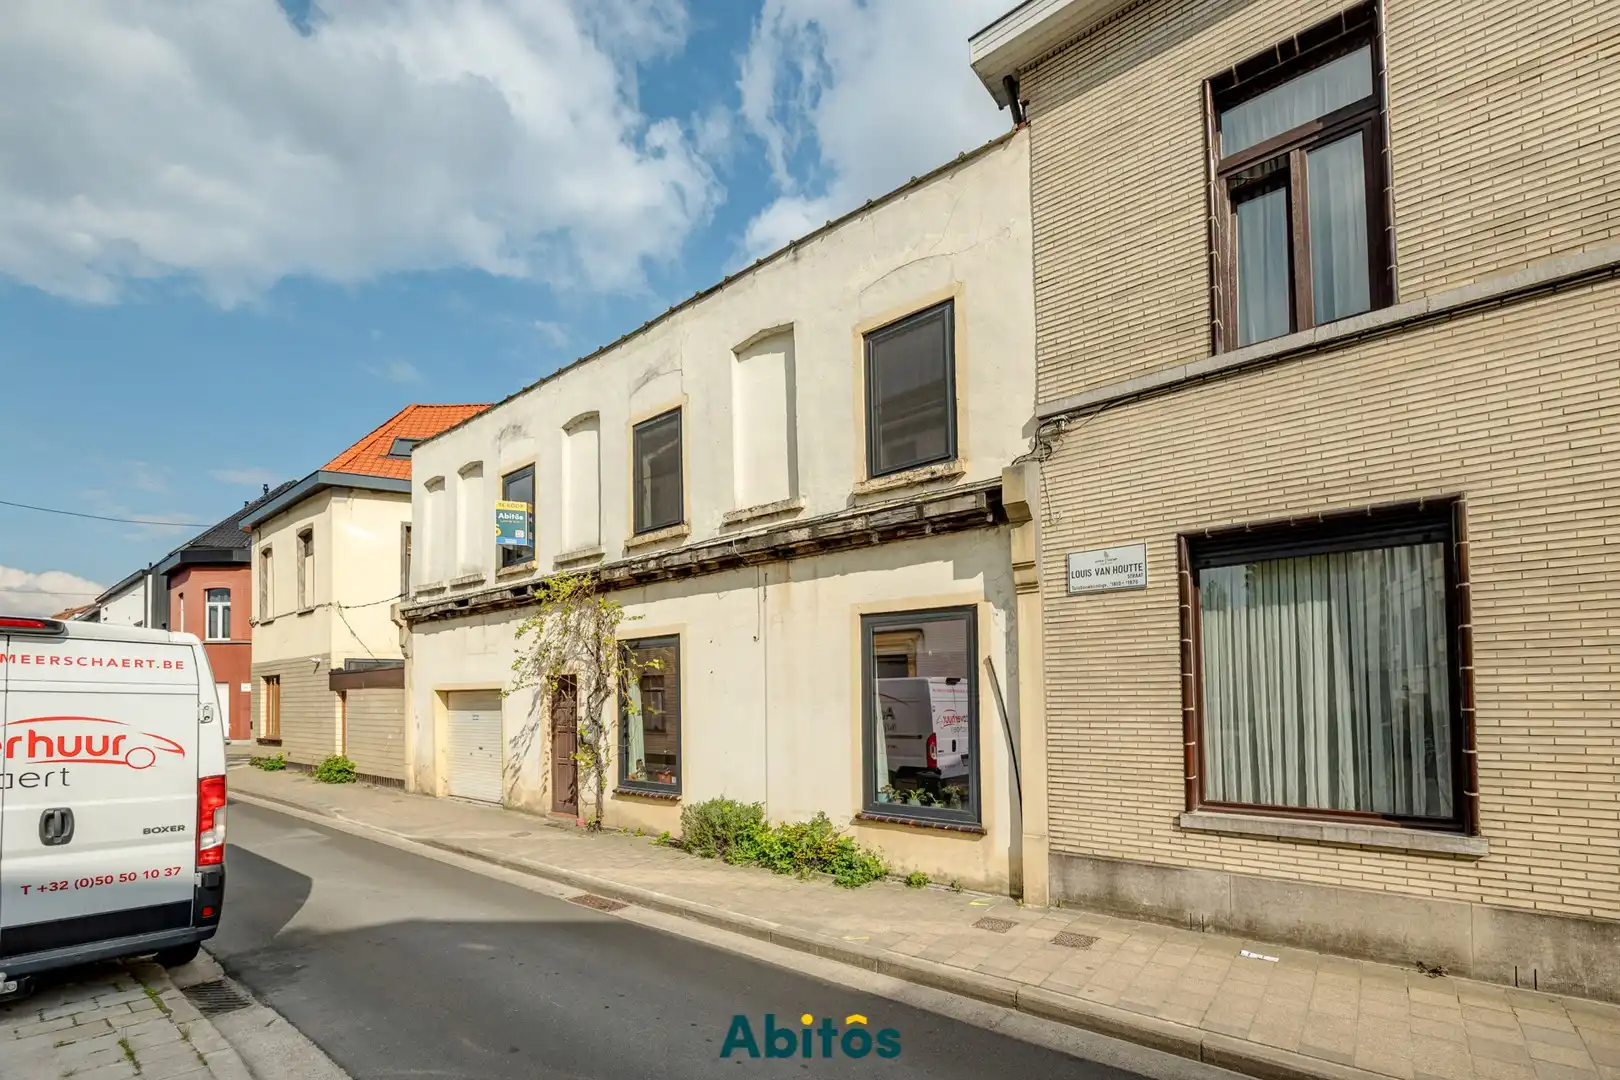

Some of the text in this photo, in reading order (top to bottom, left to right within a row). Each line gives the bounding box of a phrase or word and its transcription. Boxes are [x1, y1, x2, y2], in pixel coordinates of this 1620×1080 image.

[1071, 562, 1144, 579] LOUIS VAN HOUTTE
[0, 653, 184, 670] MEERSCHAERT.BE
[0, 729, 126, 758] rhuur
[142, 824, 186, 835] BOXER
[21, 866, 182, 895] T +32 (0)50 50 10 37
